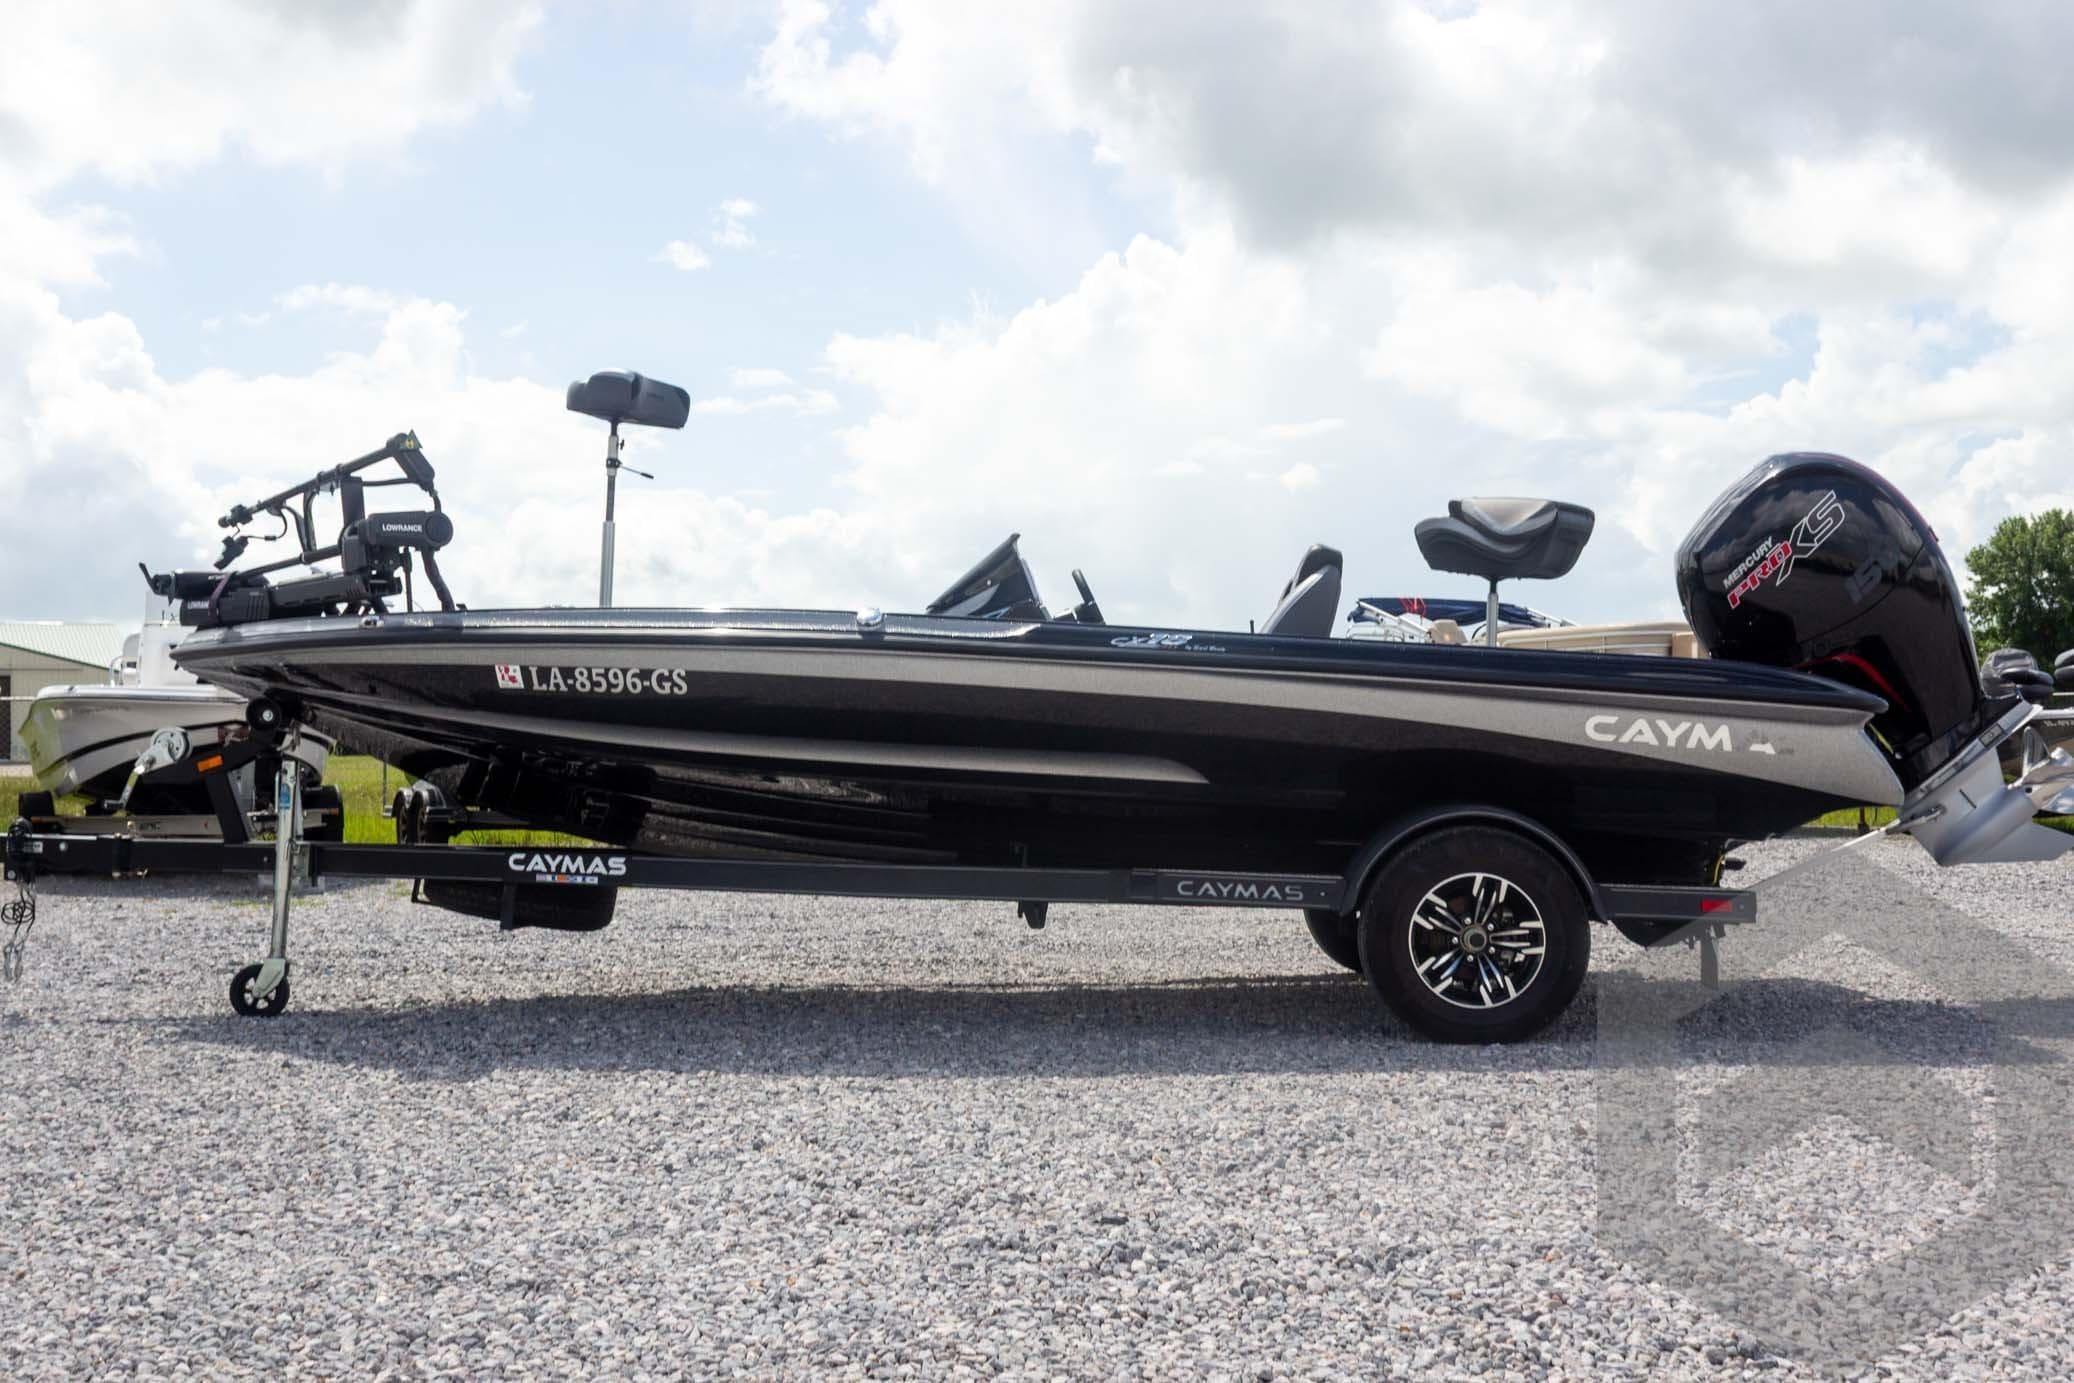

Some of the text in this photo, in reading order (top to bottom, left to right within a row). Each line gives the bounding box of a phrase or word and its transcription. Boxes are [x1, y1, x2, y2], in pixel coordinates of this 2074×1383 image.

[382, 523, 423, 532] LOWRANCE
[1727, 489, 1845, 609] PRO XS
[1722, 536, 1773, 590] MERCURY
[528, 666, 688, 695] LA-8596-GS
[508, 853, 627, 876] CAYMAS
[1176, 880, 1304, 902] CAYMAS
